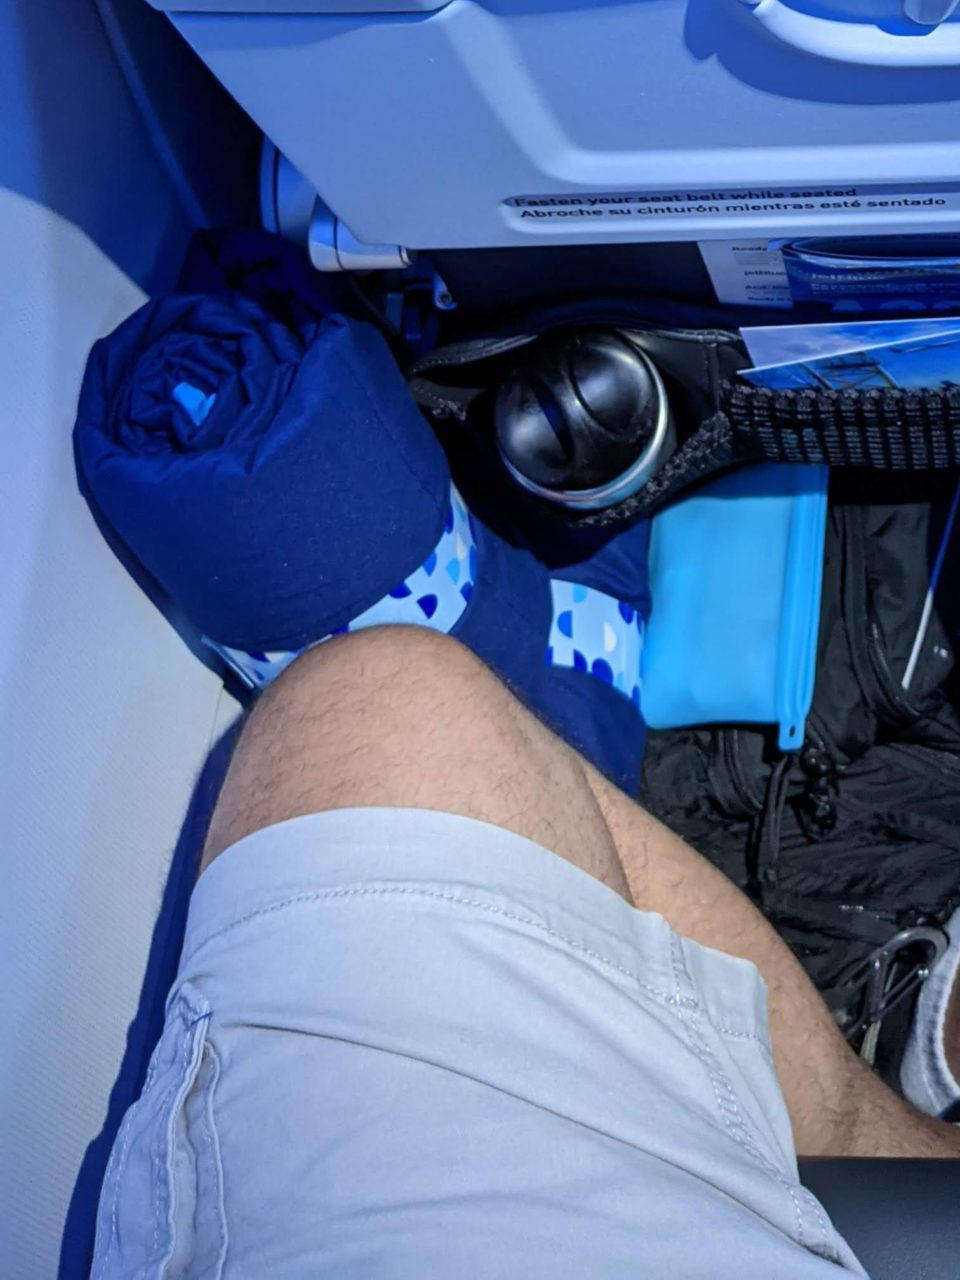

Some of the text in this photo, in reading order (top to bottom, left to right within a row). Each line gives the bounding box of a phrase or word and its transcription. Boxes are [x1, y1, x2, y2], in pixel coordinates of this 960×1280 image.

[513, 187, 858, 208] Fasten your seat belt while seated
[519, 196, 947, 219] Abroche su cinturón mientras esté sentado
